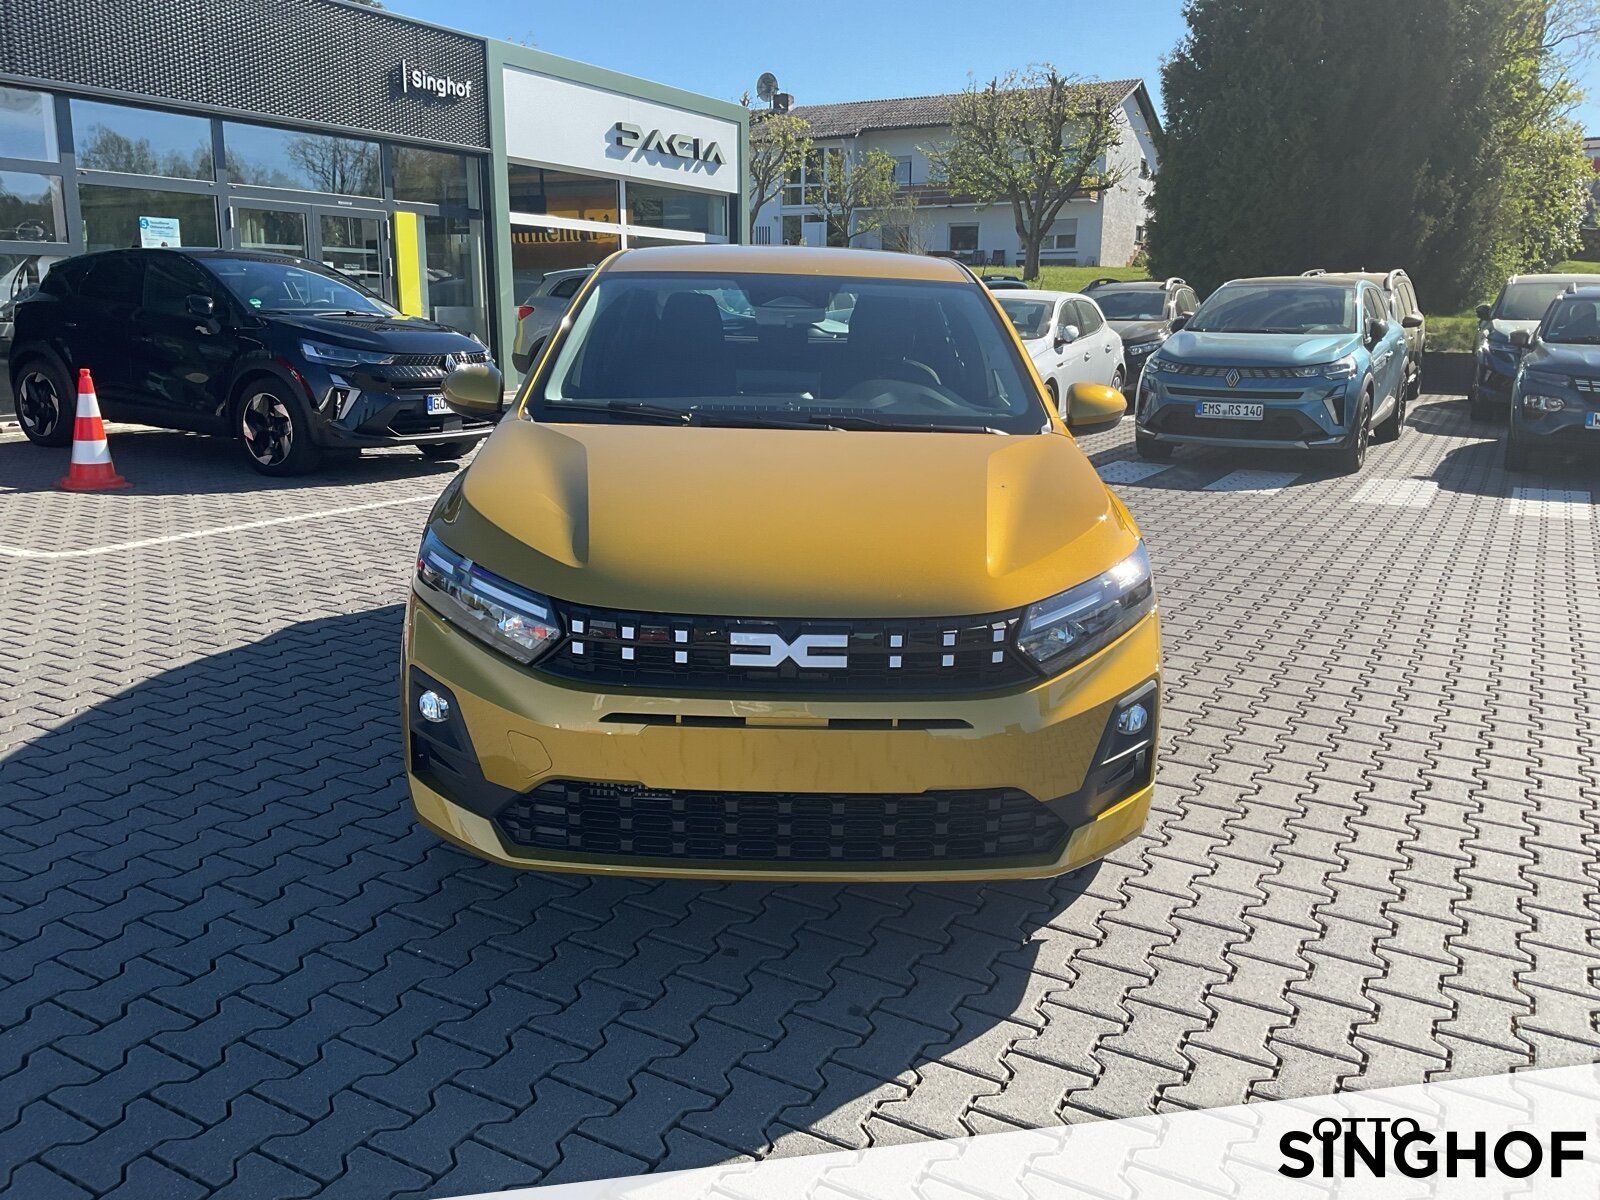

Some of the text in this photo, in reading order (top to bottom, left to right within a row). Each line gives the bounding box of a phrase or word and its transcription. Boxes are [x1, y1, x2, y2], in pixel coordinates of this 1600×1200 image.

[411, 70, 472, 98] Singhof
[615, 121, 727, 166] DACIA
[1202, 403, 1262, 417] EMS RS 140
